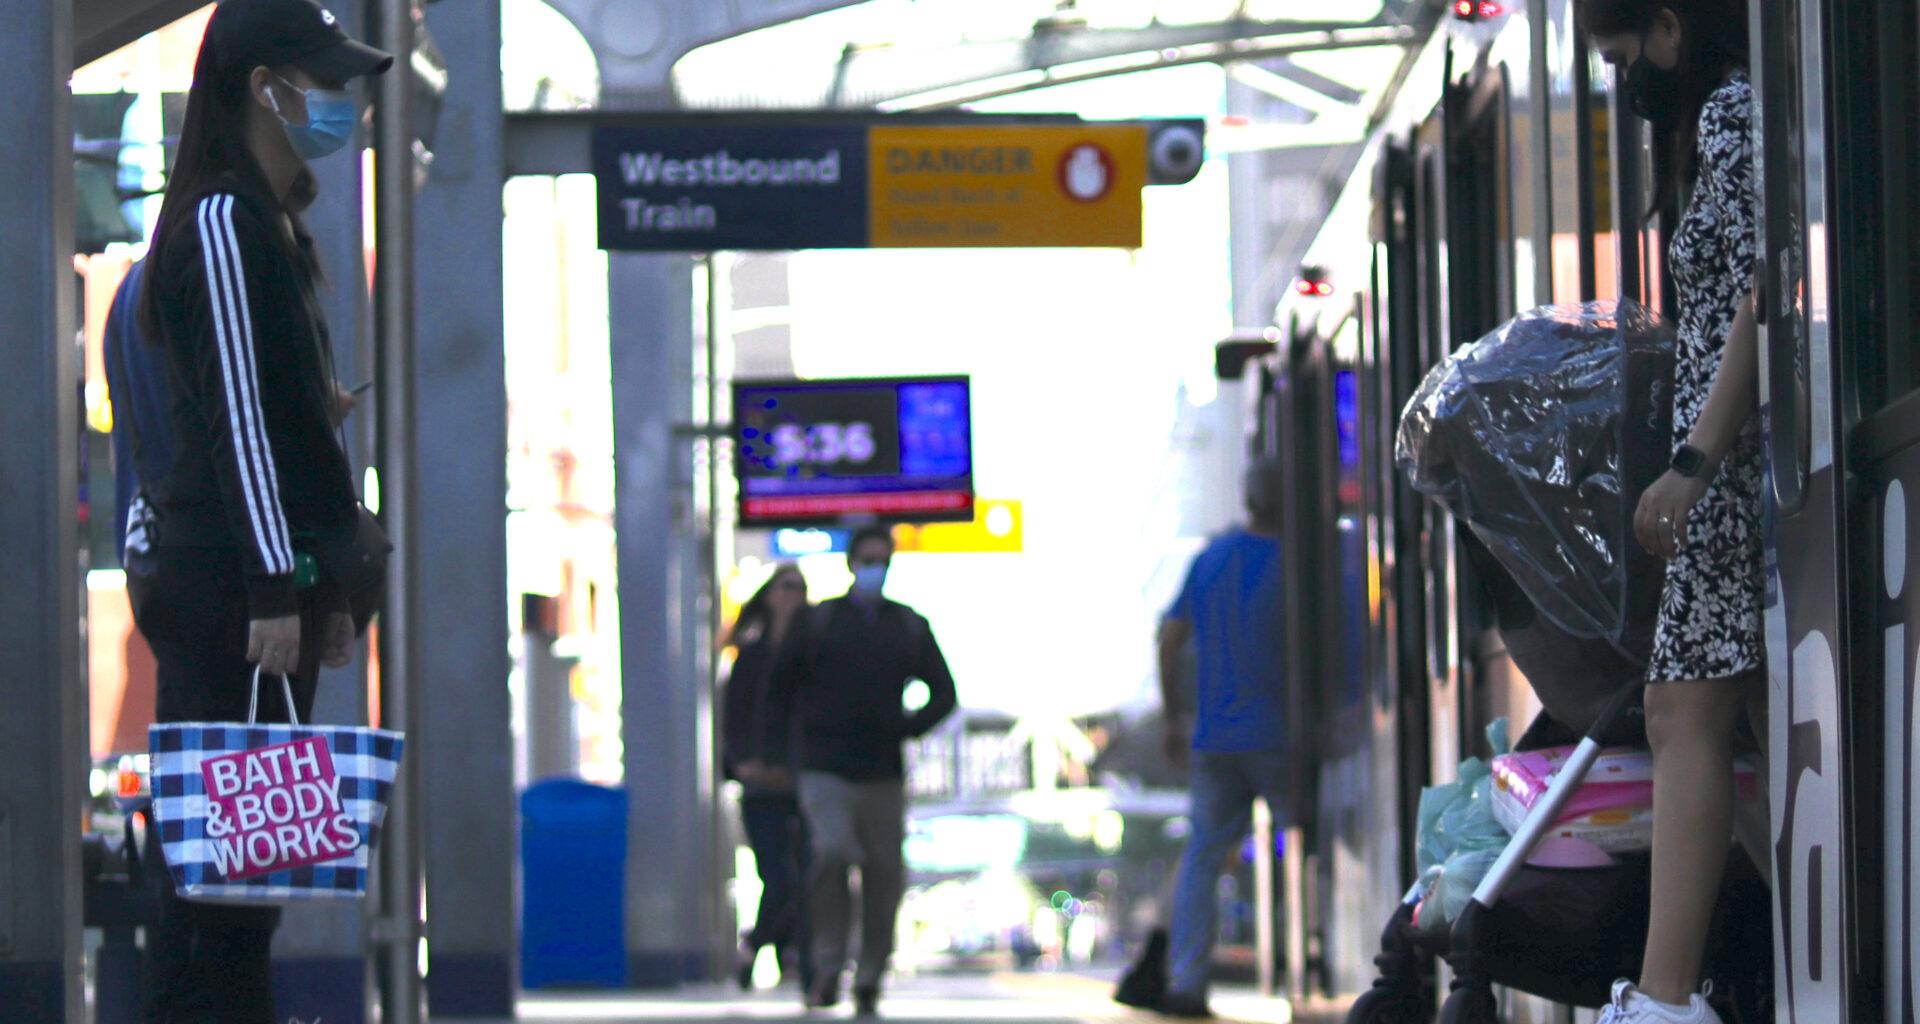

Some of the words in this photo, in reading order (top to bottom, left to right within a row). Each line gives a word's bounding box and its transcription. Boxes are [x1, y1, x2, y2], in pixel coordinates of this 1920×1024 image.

[619, 151, 840, 185] Westbound
[887, 147, 1034, 175] DANGER
[620, 199, 716, 231] Train
[773, 424, 875, 463] 5:36
[211, 742, 320, 797] BATH
[206, 802, 236, 837] &
[235, 776, 341, 831] BODY
[208, 814, 361, 877] WORKS
